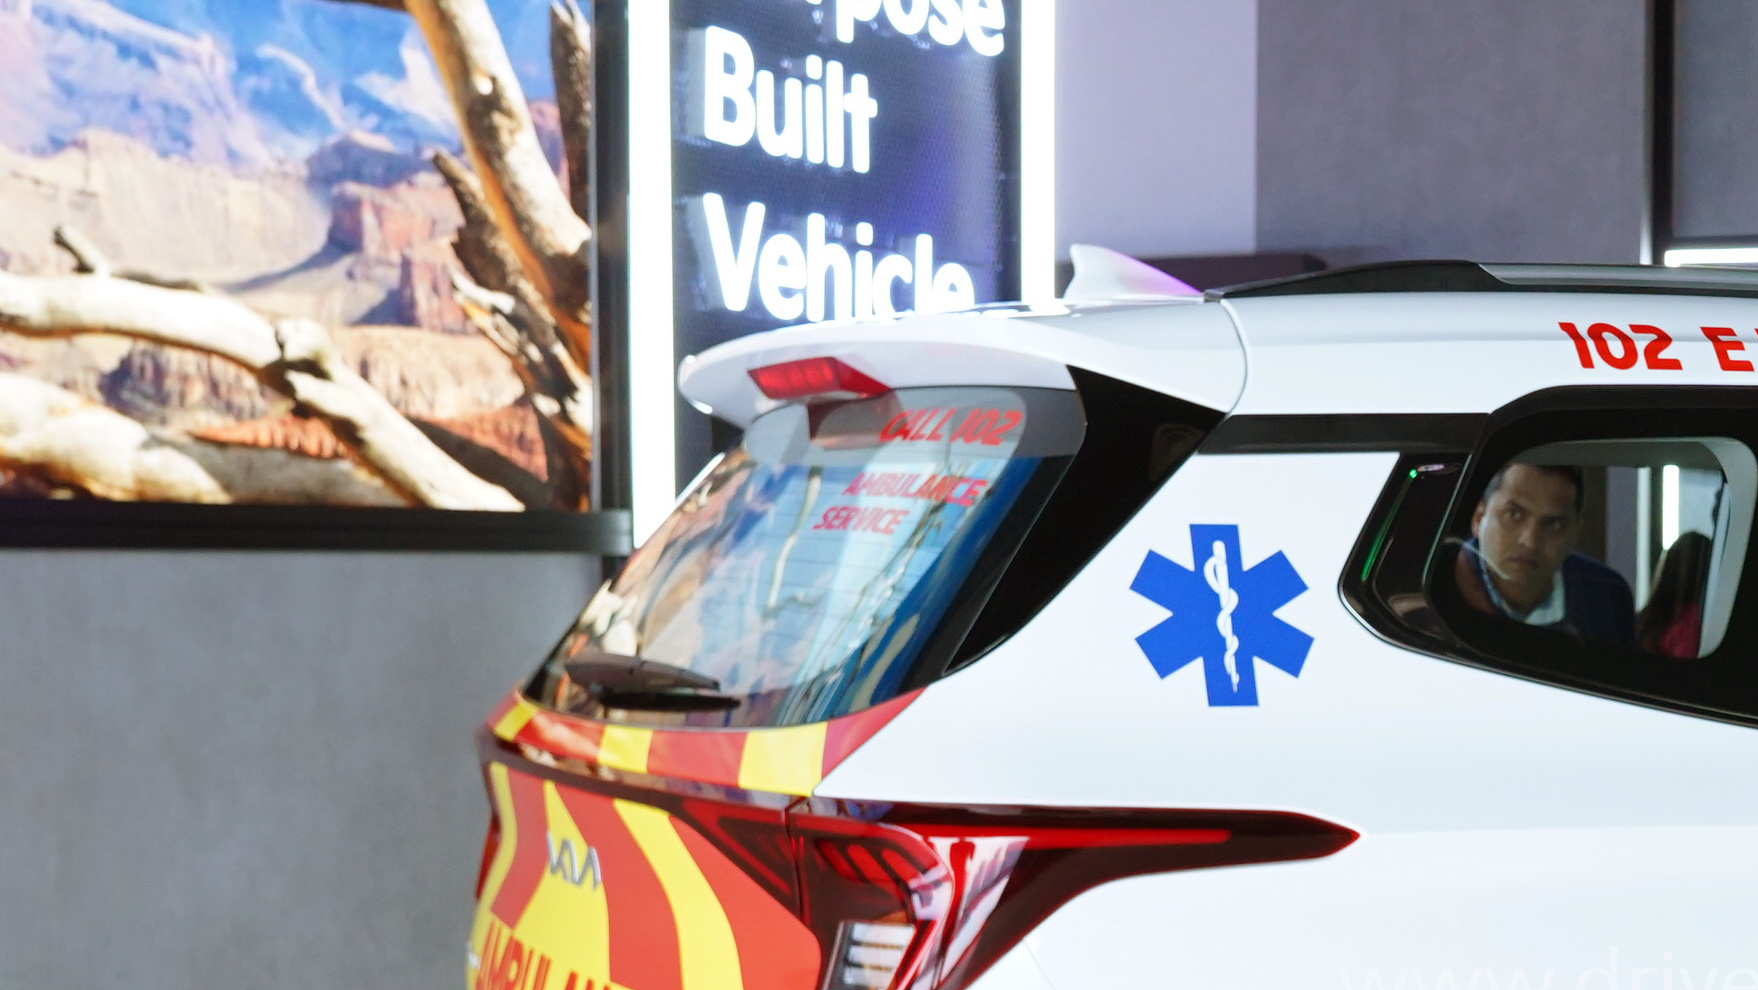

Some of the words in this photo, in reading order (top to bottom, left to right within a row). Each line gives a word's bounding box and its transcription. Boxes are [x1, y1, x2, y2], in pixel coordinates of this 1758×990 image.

[704, 26, 878, 173] Built
[703, 192, 975, 322] Vehicle
[1558, 321, 1683, 371] 102
[878, 408, 956, 443] CALL
[949, 408, 1023, 446] 102
[842, 473, 989, 507] AMBULANCE
[812, 505, 911, 535] SERVICE
